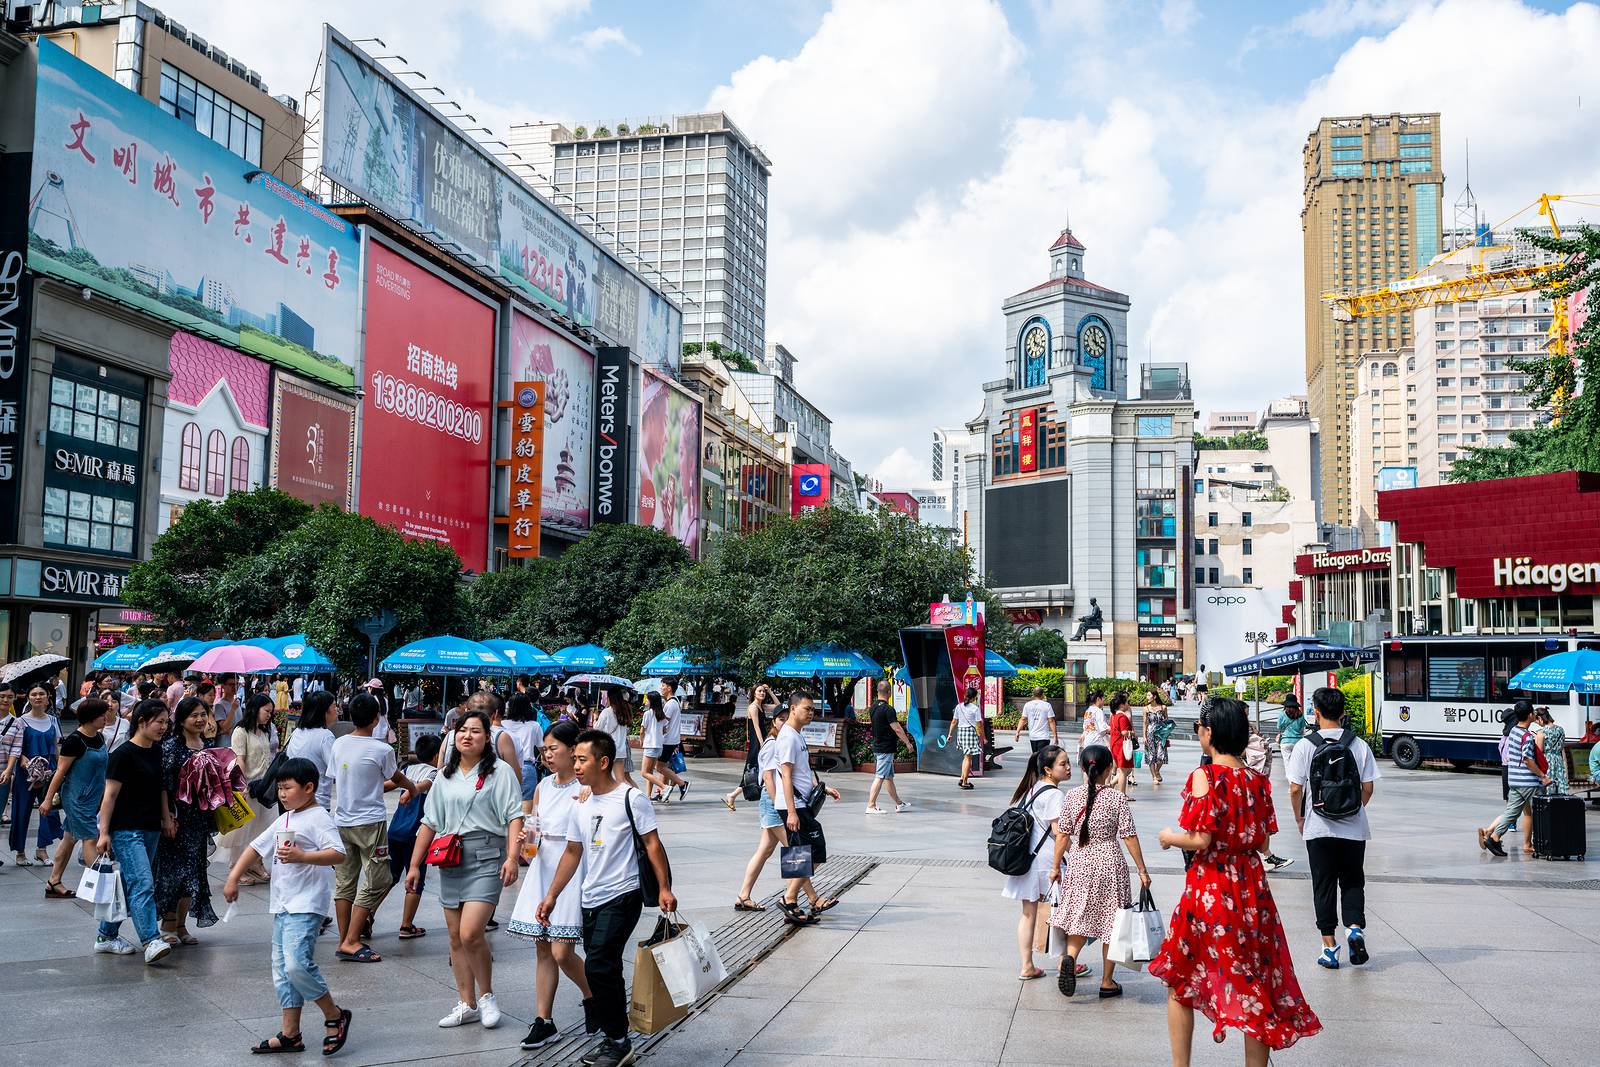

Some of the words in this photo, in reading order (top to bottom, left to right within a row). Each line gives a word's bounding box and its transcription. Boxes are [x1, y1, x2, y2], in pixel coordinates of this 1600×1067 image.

[65, 112, 340, 291] 文明城市共建共享
[433, 140, 490, 210] 优雅时尚
[431, 178, 489, 242] 品位锦江
[375, 276, 411, 302] ADVERTISING
[376, 263, 395, 284] BROAD
[521, 245, 564, 303] 12315
[407, 342, 459, 391] 招商热线
[372, 371, 484, 446] 13880200200
[55, 448, 103, 480] SEMIR
[106, 460, 136, 485] 森馬
[597, 365, 620, 516] Meters/bonwe
[1021, 415, 1033, 467] 鳳祥樓
[513, 412, 537, 538] 雪豹皮草行
[43, 566, 100, 597] SEMIR
[1444, 708, 1457, 723] 警
